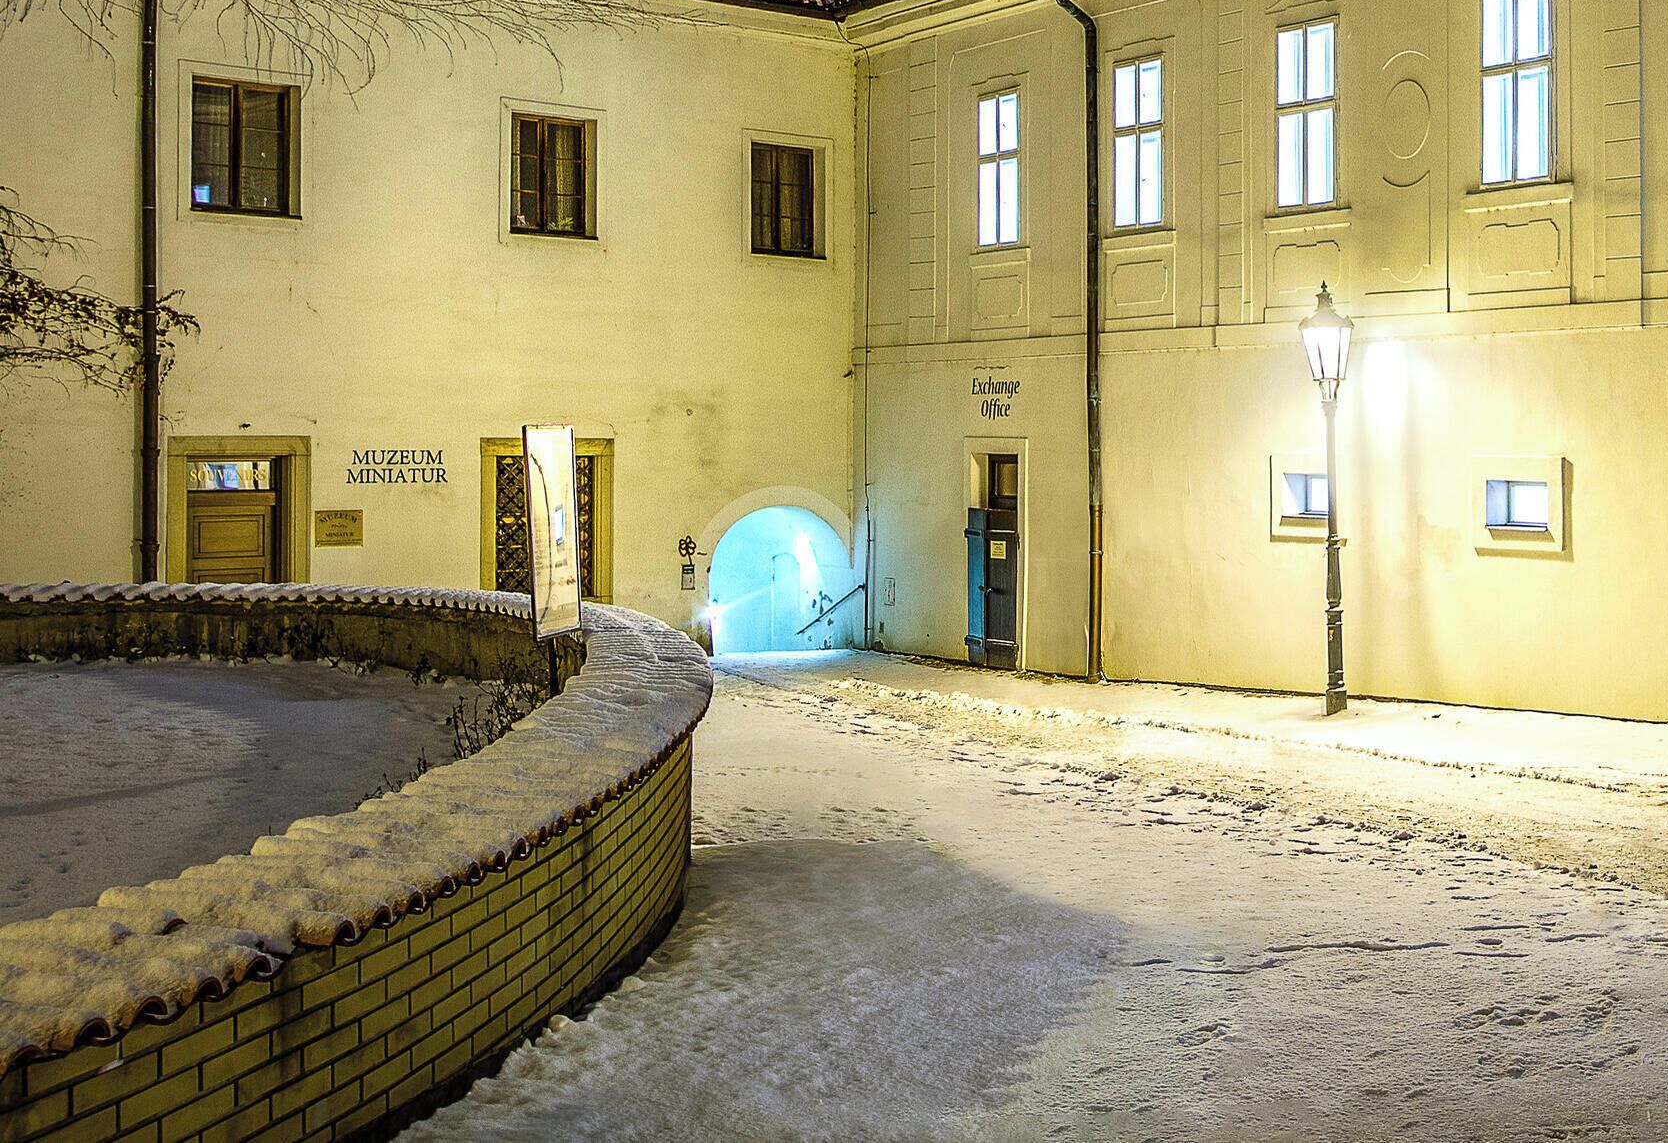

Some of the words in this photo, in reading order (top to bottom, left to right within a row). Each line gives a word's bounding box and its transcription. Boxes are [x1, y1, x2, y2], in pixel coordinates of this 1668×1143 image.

[972, 376, 1020, 399] Exchange
[981, 398, 1010, 420] Office
[352, 449, 443, 465] MUZEUM
[189, 468, 267, 482] SOUVENIRS
[346, 468, 448, 483] MINIATUR
